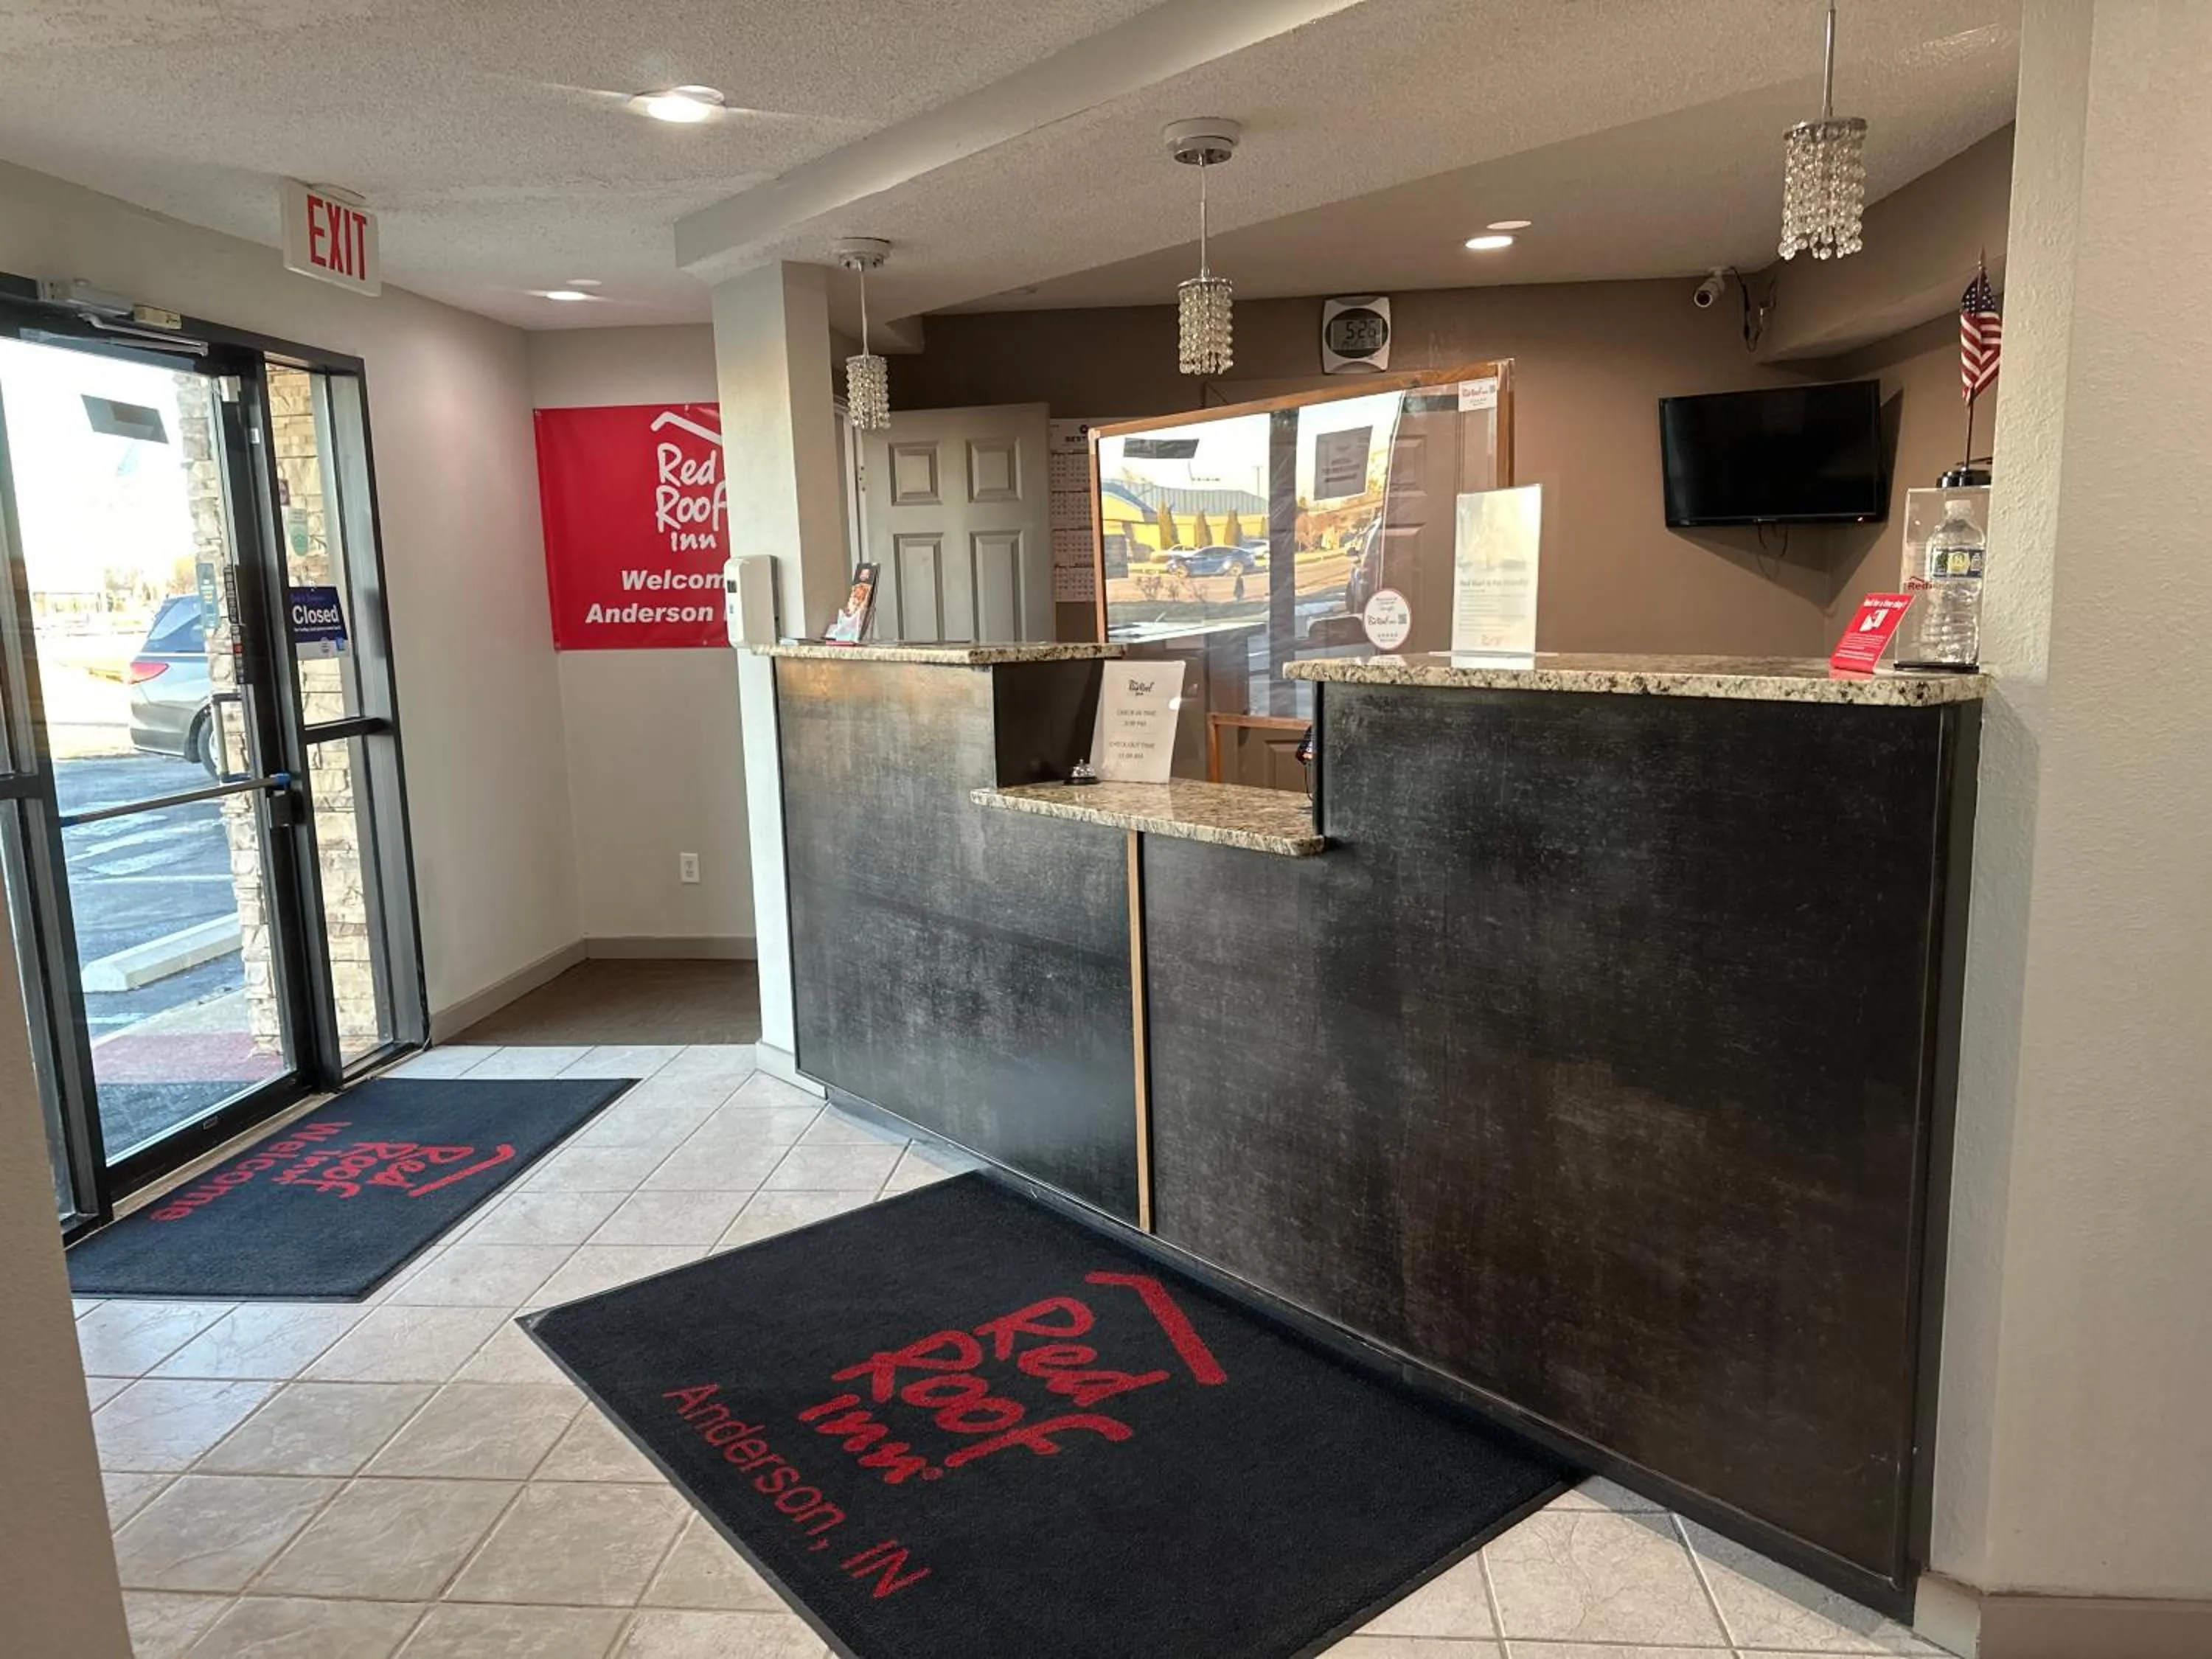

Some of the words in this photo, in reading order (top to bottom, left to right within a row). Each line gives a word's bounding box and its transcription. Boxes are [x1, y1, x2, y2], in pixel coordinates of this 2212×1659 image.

[307, 194, 367, 281] EXIT
[657, 442, 717, 487] Red
[655, 480, 727, 533] Roof
[622, 568, 726, 591] Welcom
[292, 605, 339, 625] Closed
[585, 602, 713, 624] Anderson
[150, 1121, 352, 1221] Welcome
[291, 1141, 419, 1198] Roof
[366, 1145, 475, 1188] Red
[974, 1296, 1170, 1407] Red
[832, 1329, 1133, 1468] Roof
[661, 1382, 846, 1553] Anderson,
[841, 1538, 931, 1599] IN
